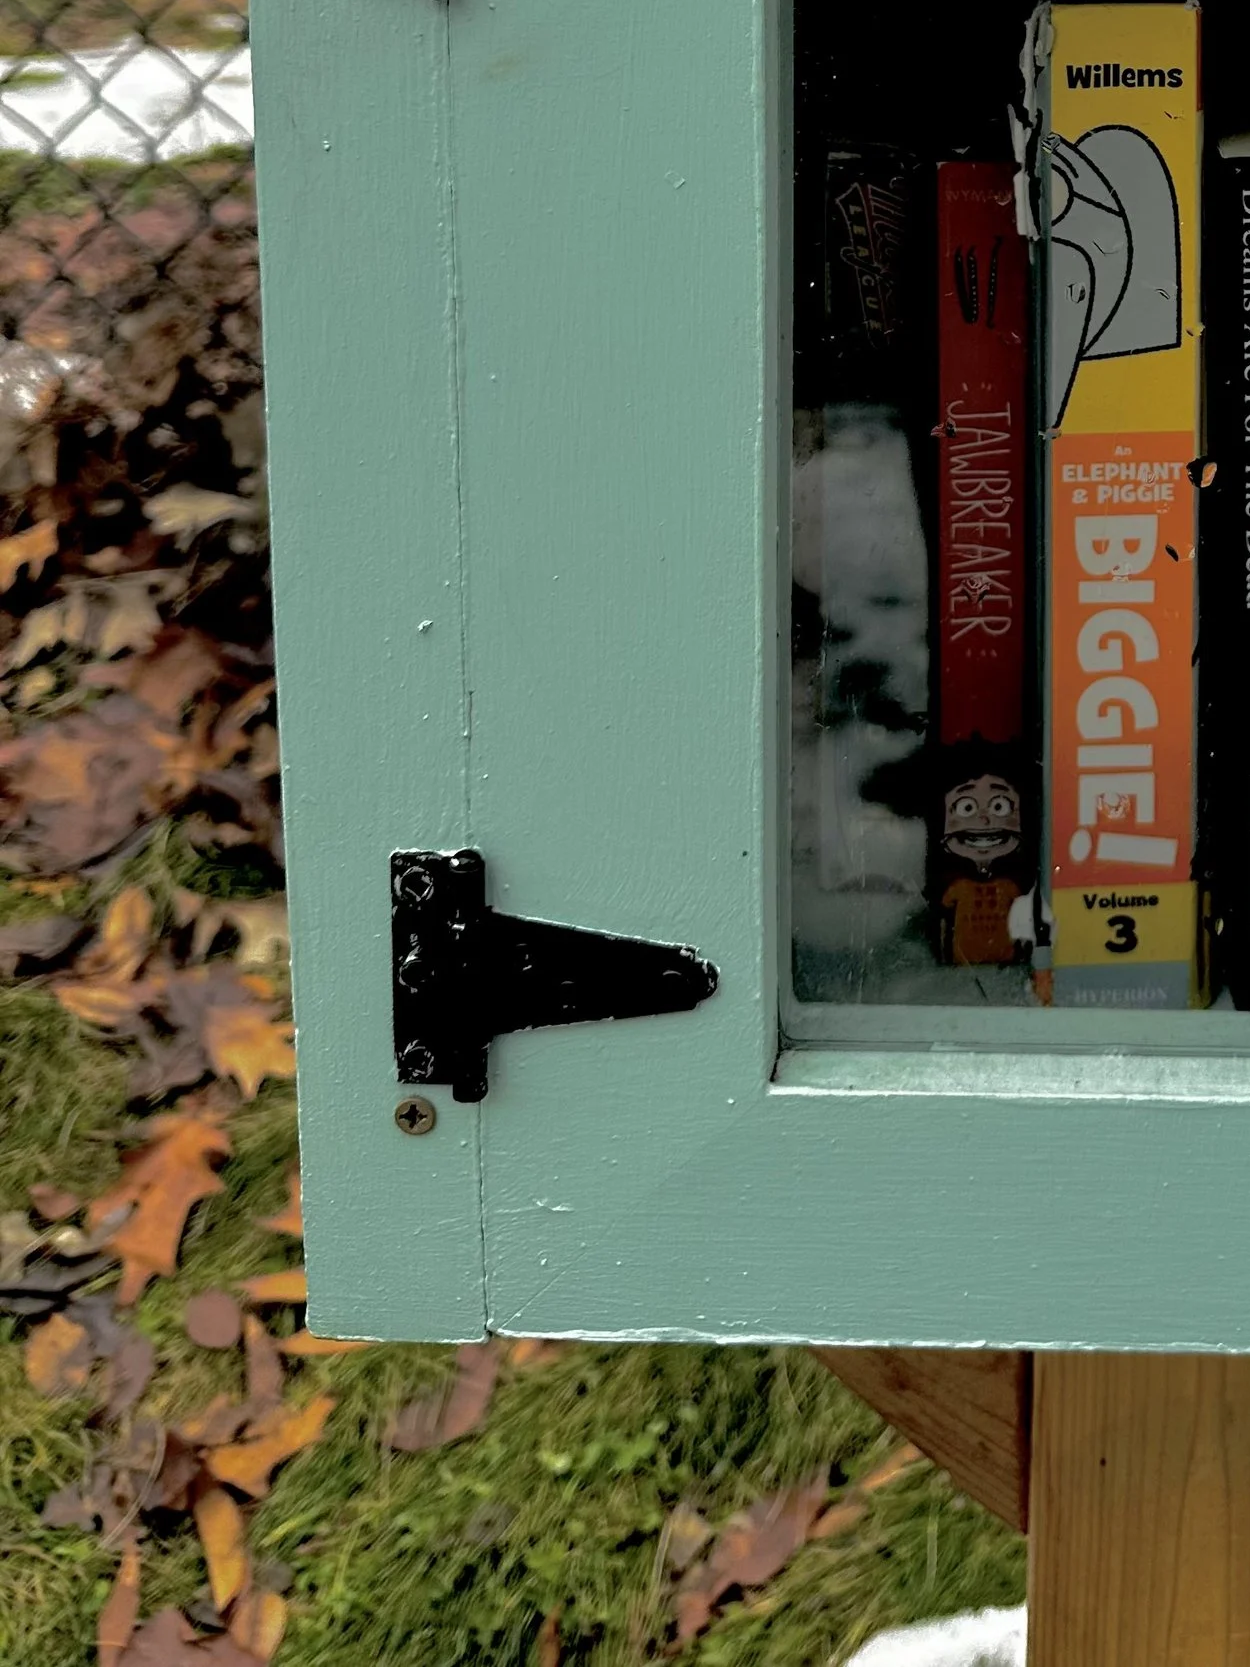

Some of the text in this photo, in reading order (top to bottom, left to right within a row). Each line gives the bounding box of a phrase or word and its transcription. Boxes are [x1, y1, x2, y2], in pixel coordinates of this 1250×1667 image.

[1066, 63, 1184, 90] Willems
[1113, 444, 1133, 457] An
[1061, 462, 1185, 483] ELEPHANT
[1072, 483, 1175, 505] & PIGGIE
[946, 400, 1013, 644] JAWBREAKER
[1070, 514, 1179, 869] BIGGIE!
[1082, 892, 1160, 910] Volume
[1105, 915, 1140, 954] 3
